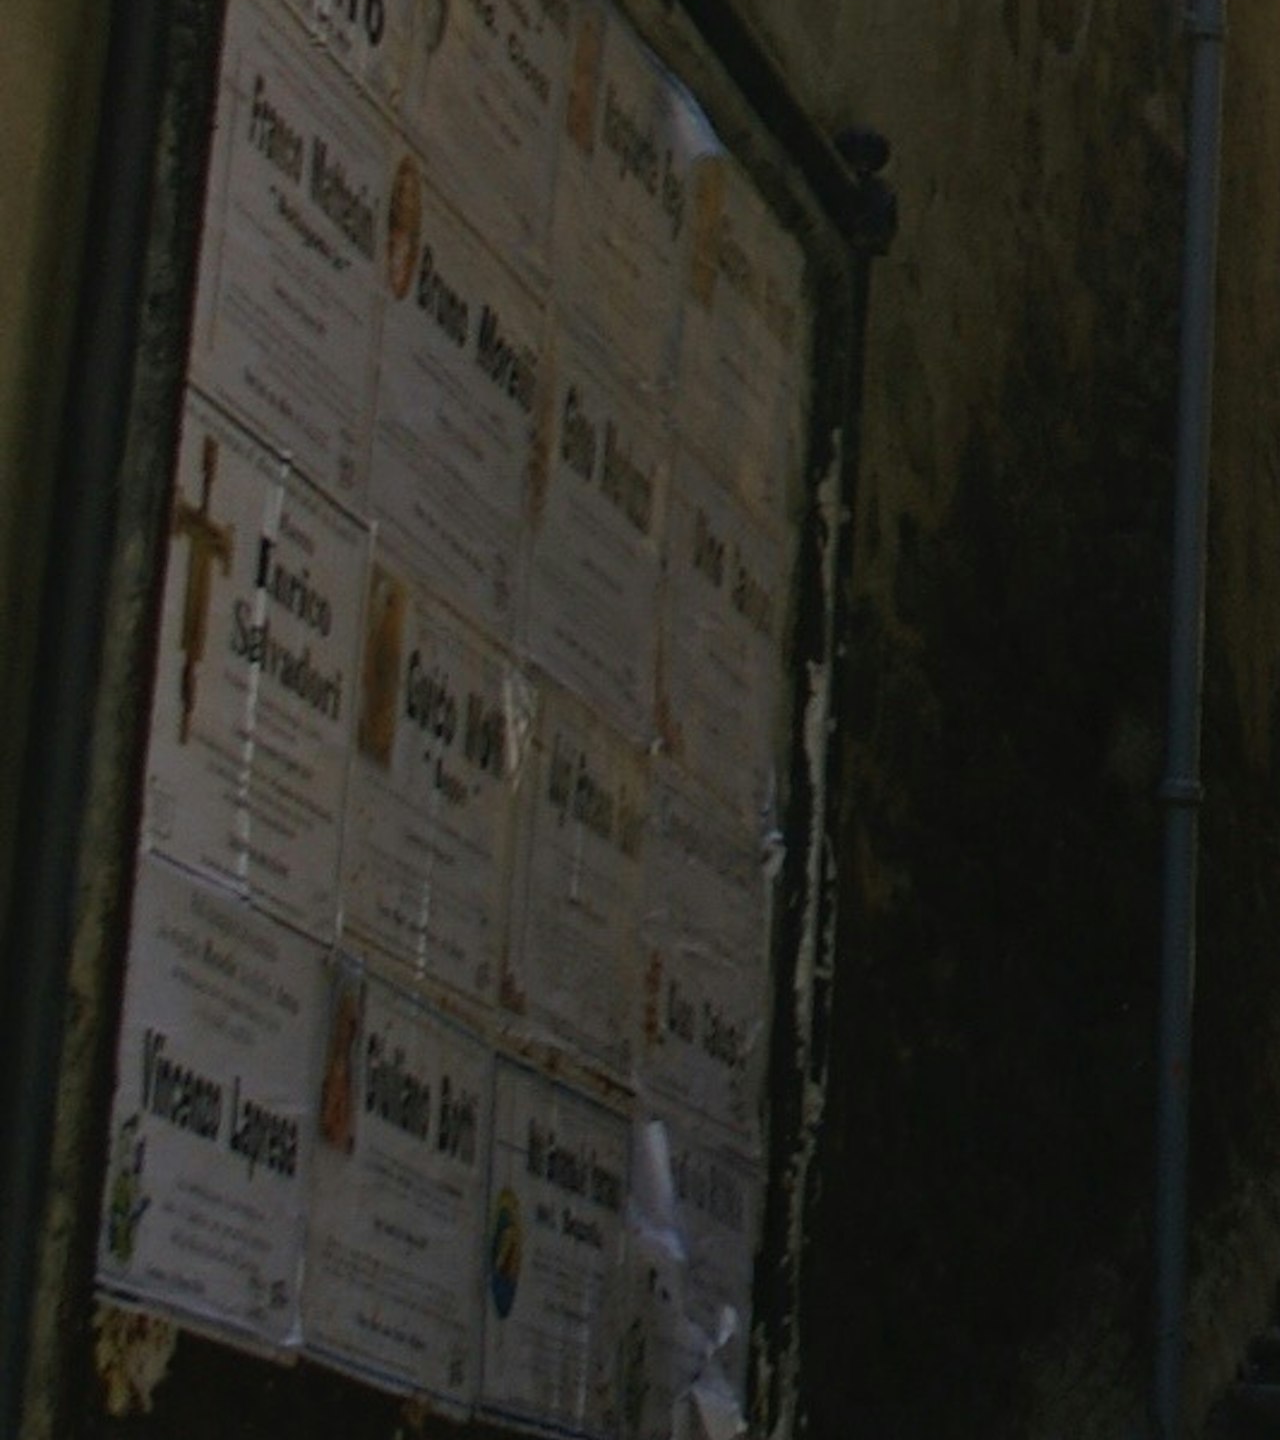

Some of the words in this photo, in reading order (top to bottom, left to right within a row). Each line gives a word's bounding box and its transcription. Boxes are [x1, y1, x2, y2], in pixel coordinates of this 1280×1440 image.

[249, 74, 303, 187] Franco
[416, 246, 469, 349] Bruno
[257, 537, 333, 638] Enrico
[231, 600, 343, 723] Salvadori
[142, 1027, 222, 1142] Vincenzo
